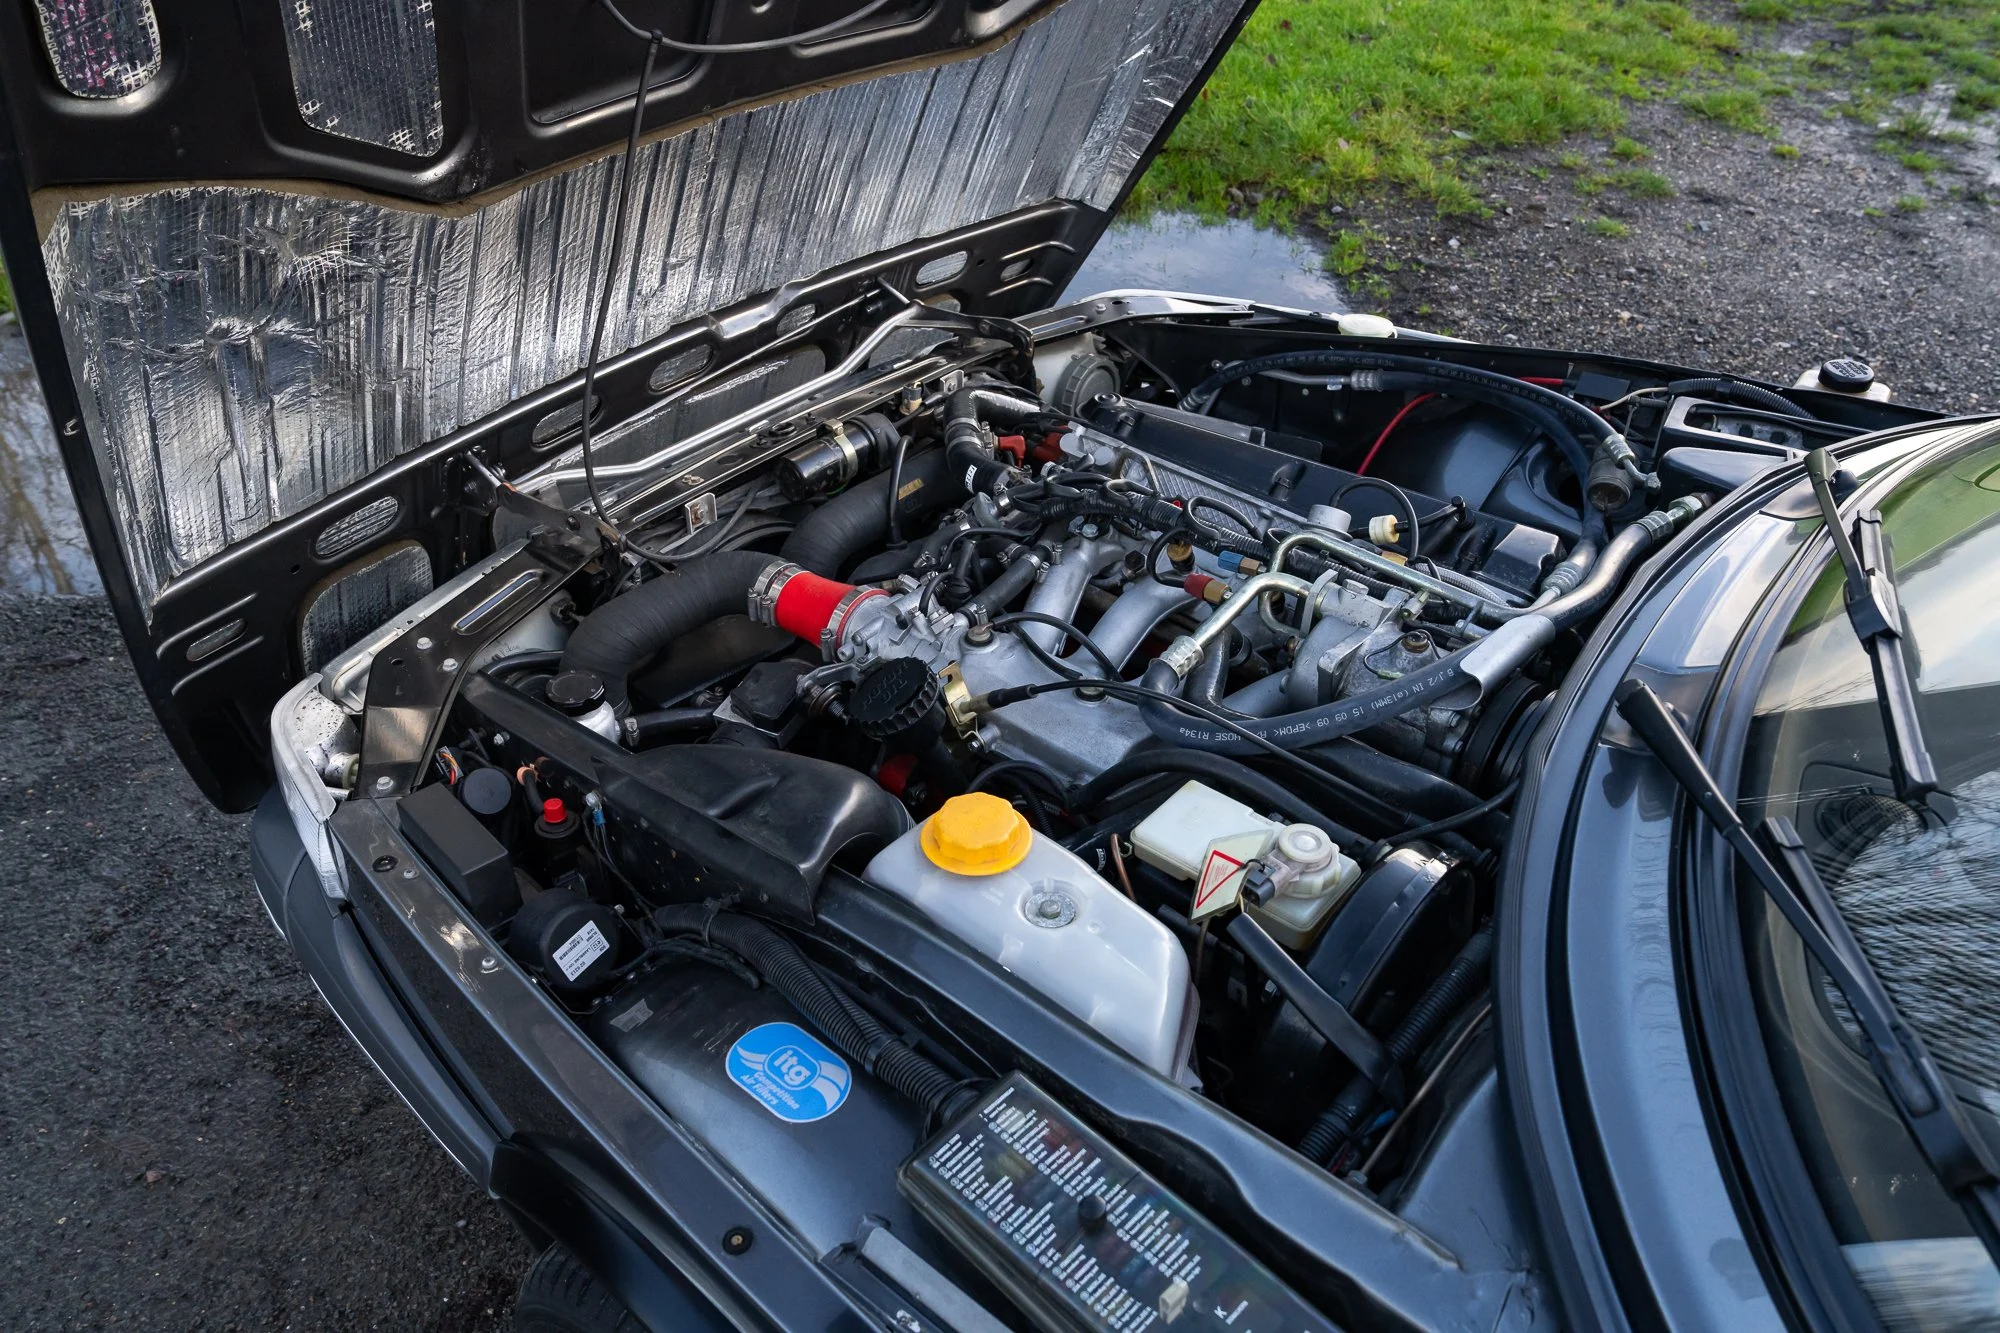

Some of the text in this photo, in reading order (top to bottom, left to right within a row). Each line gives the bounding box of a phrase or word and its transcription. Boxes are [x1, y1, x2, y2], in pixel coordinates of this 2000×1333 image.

[1412, 682, 1424, 694] IN
[1335, 712, 1348, 723] 09
[1352, 706, 1364, 717] 15
[1316, 717, 1330, 727] 09
[1179, 727, 1209, 740] R134a
[773, 1049, 812, 1086] itg
[740, 1074, 779, 1105] Air Filters
[753, 1070, 800, 1110] Competition
[1214, 1305, 1227, 1320] K
